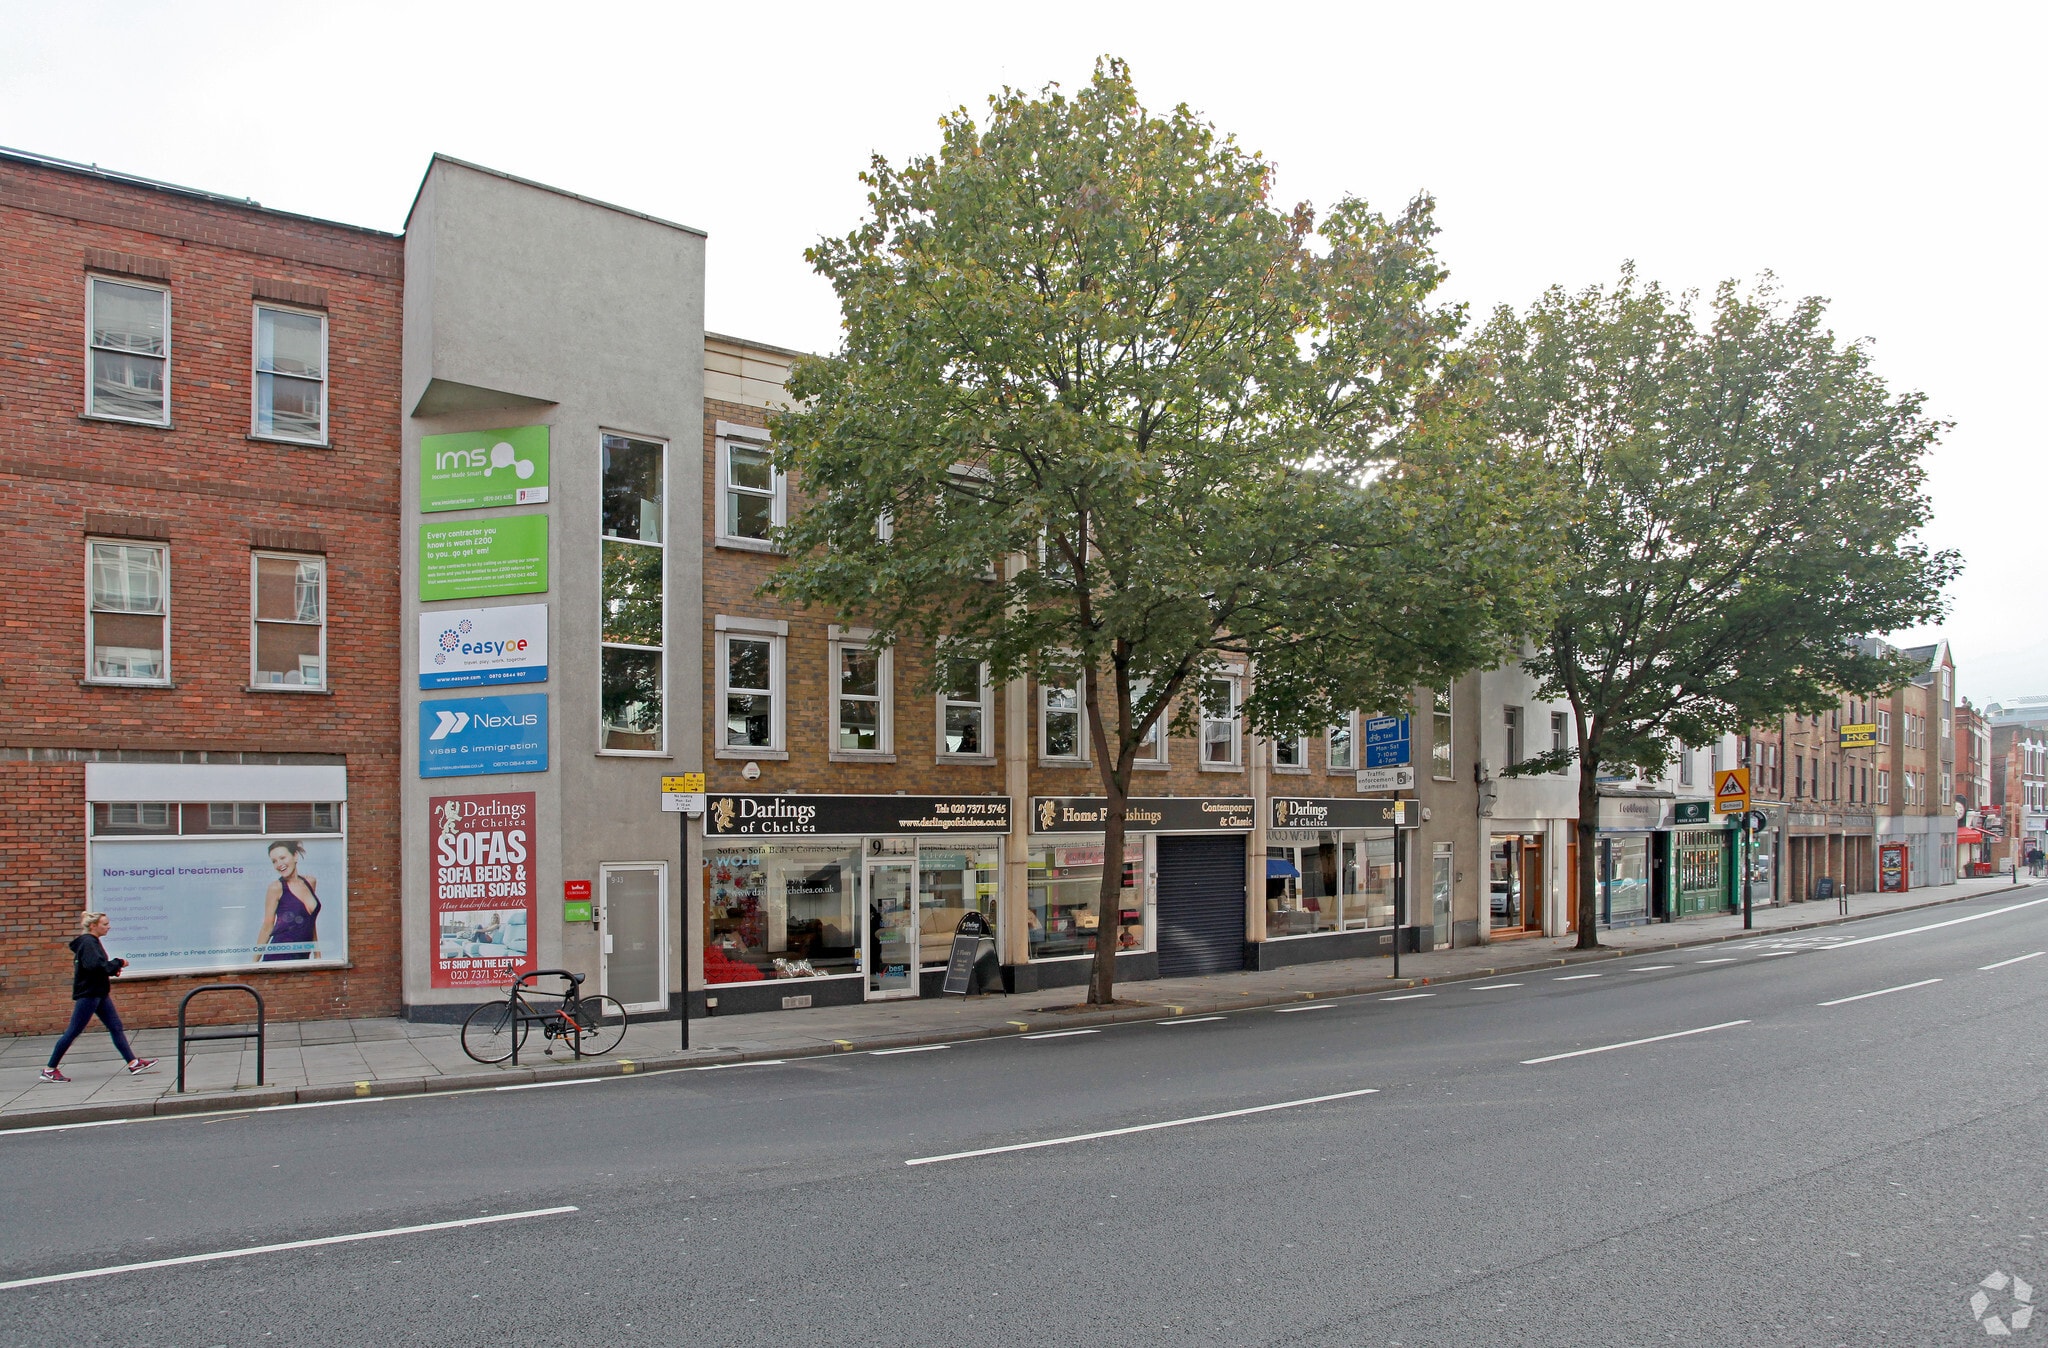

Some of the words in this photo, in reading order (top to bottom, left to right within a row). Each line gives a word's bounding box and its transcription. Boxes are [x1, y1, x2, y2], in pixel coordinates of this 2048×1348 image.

[427, 532, 446, 540] Every
[448, 529, 482, 538] contractor
[484, 528, 497, 536] you
[427, 541, 445, 549] know
[474, 537, 493, 545] £200
[462, 548, 473, 558] get
[462, 639, 528, 657] easyoe
[436, 675, 481, 683] www.easyoe.com
[474, 714, 538, 728] Nexus
[1846, 733, 1870, 741] HNG
[472, 743, 538, 752] immigration
[464, 800, 526, 819] Darlings
[740, 798, 816, 824] Darlings
[935, 803, 950, 813] Tel:
[950, 804, 966, 814] 020
[967, 804, 986, 814] 7371
[987, 803, 1006, 814] 5745
[1201, 801, 1253, 815] Contemporary
[1289, 801, 1328, 820] Darlings
[1062, 807, 1098, 822] Home
[1099, 807, 1162, 825] Fishings
[1219, 816, 1228, 826] &
[1228, 816, 1253, 826] Classic
[1289, 817, 1298, 827] of
[1300, 817, 1328, 827] Chelsea
[464, 819, 475, 829] of
[481, 818, 526, 828] Chelsea
[741, 821, 756, 832] of
[761, 821, 816, 833] Chelsea
[898, 817, 1007, 829] www.darlingsofchelsea.co.uk
[438, 830, 527, 867] SOFAS
[748, 846, 766, 854] Sofa
[103, 867, 175, 878] Non-surgical
[178, 866, 244, 875] treatments
[438, 866, 473, 884] SOFA
[475, 865, 511, 882] BEDS
[515, 864, 526, 880] &
[439, 883, 486, 899] CORNER
[488, 881, 527, 897] SOFAS
[500, 898, 509, 907] the
[511, 899, 528, 908] UK
[439, 961, 451, 970] 1ST
[452, 960, 471, 969] SHOP
[472, 959, 483, 968] ON
[483, 959, 496, 968] THE
[498, 958, 513, 967] LEFT
[888, 964, 904, 972] best
[451, 970, 468, 980] 020
[471, 969, 490, 979] 7371
